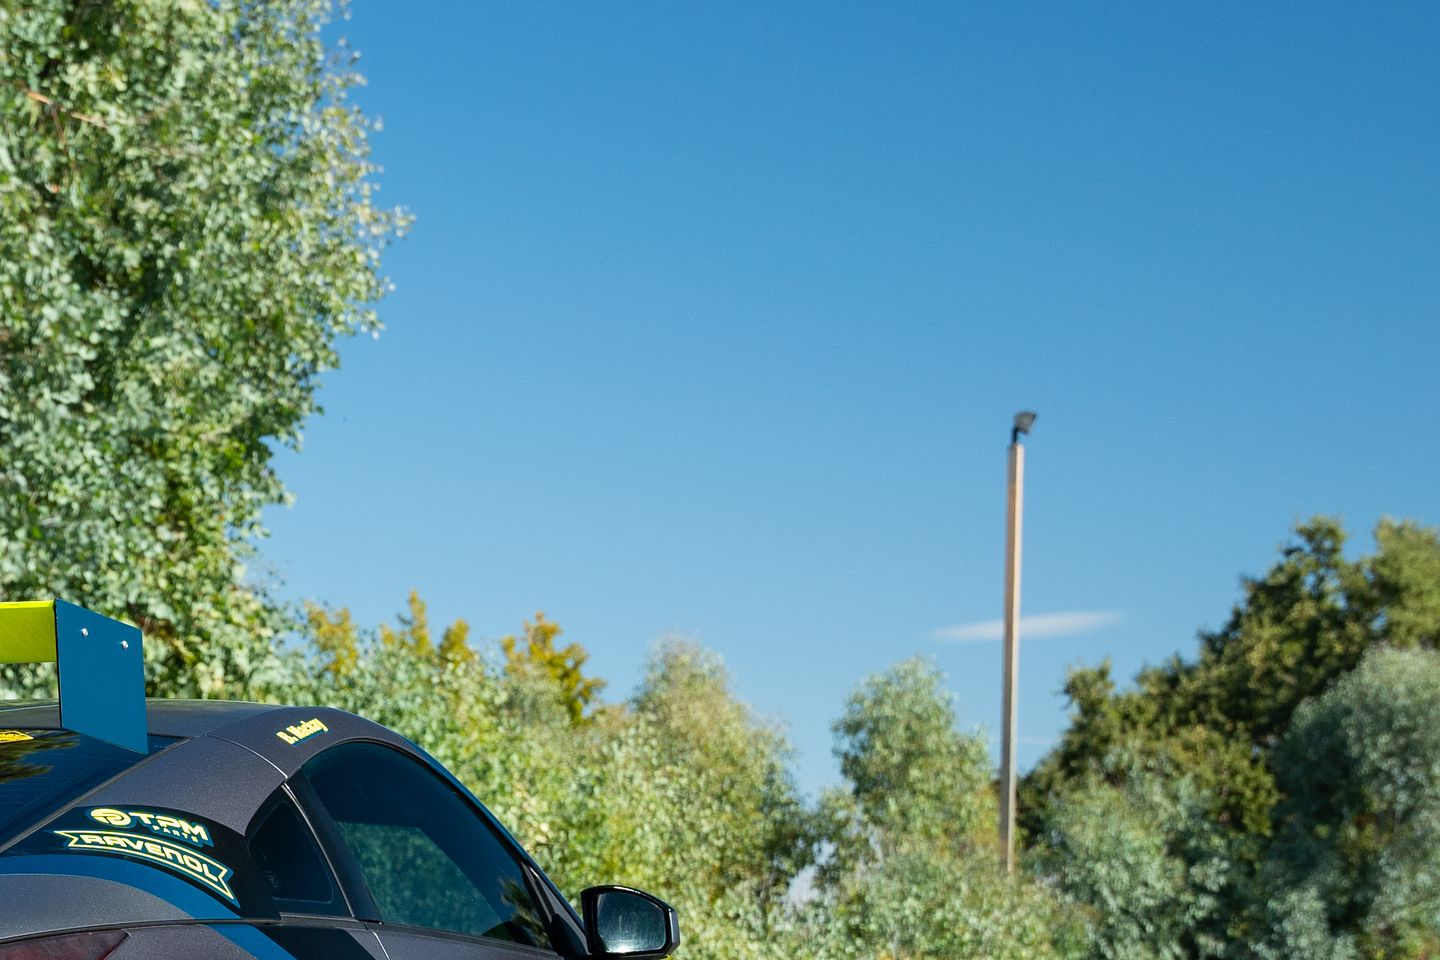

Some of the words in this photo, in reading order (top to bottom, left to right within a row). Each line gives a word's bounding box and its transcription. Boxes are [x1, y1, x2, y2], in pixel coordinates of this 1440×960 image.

[129, 812, 209, 841] TPM
[152, 825, 199, 843] PARTS
[79, 834, 219, 882] RAVENOL
